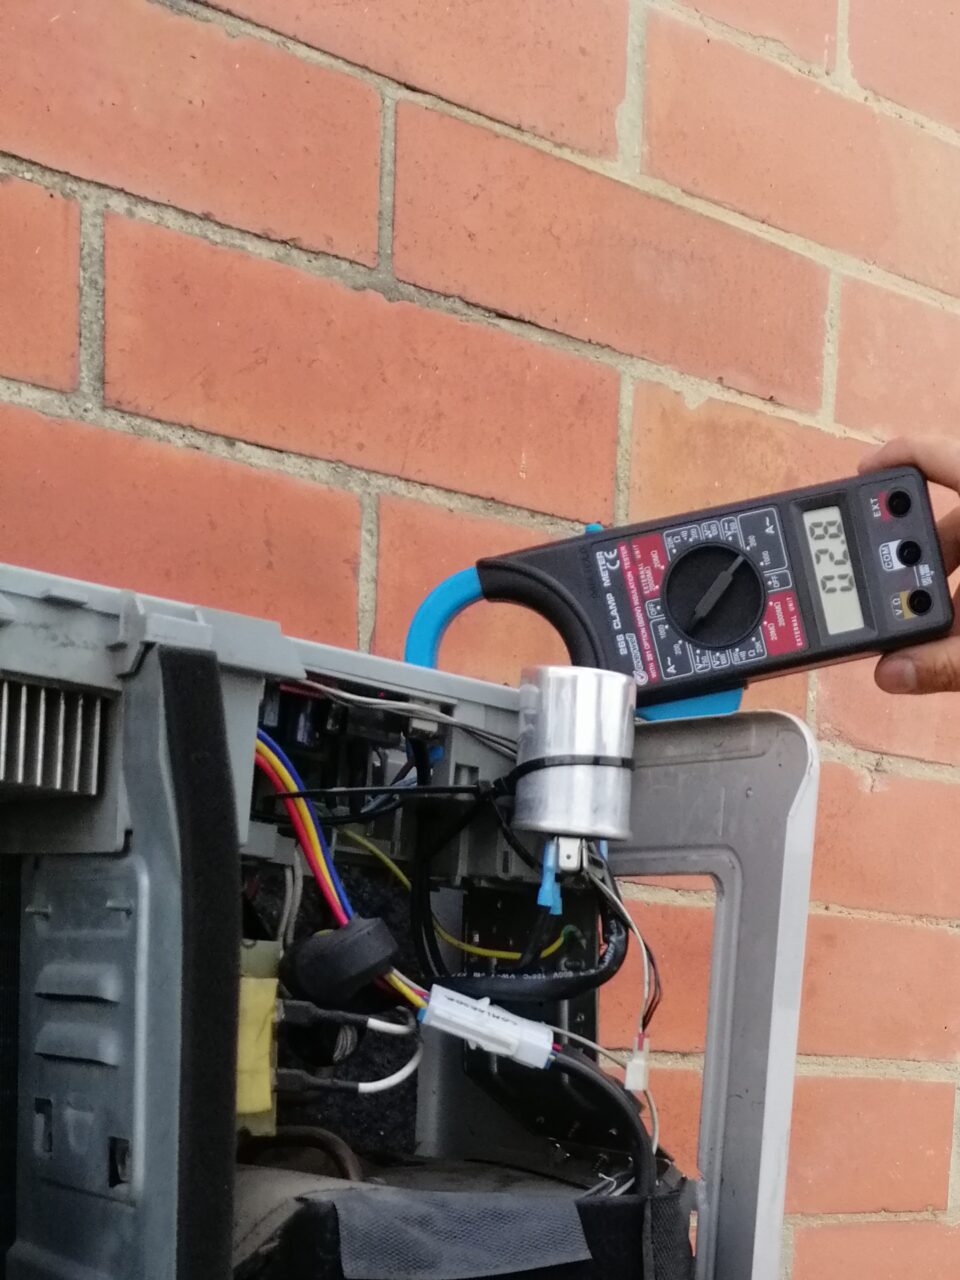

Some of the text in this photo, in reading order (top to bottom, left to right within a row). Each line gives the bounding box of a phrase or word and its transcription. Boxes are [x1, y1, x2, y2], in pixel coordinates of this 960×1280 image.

[872, 498, 881, 517] EXT
[620, 545, 630, 568] TESTER
[882, 546, 892, 568] COM
[595, 551, 611, 586] METER
[627, 571, 639, 605] INSULATION
[770, 575, 780, 588] OFF
[606, 593, 620, 629] CLAMP
[648, 601, 657, 616] OFF
[640, 626, 650, 649] OPTION
[791, 616, 802, 645] EXTERNAL
